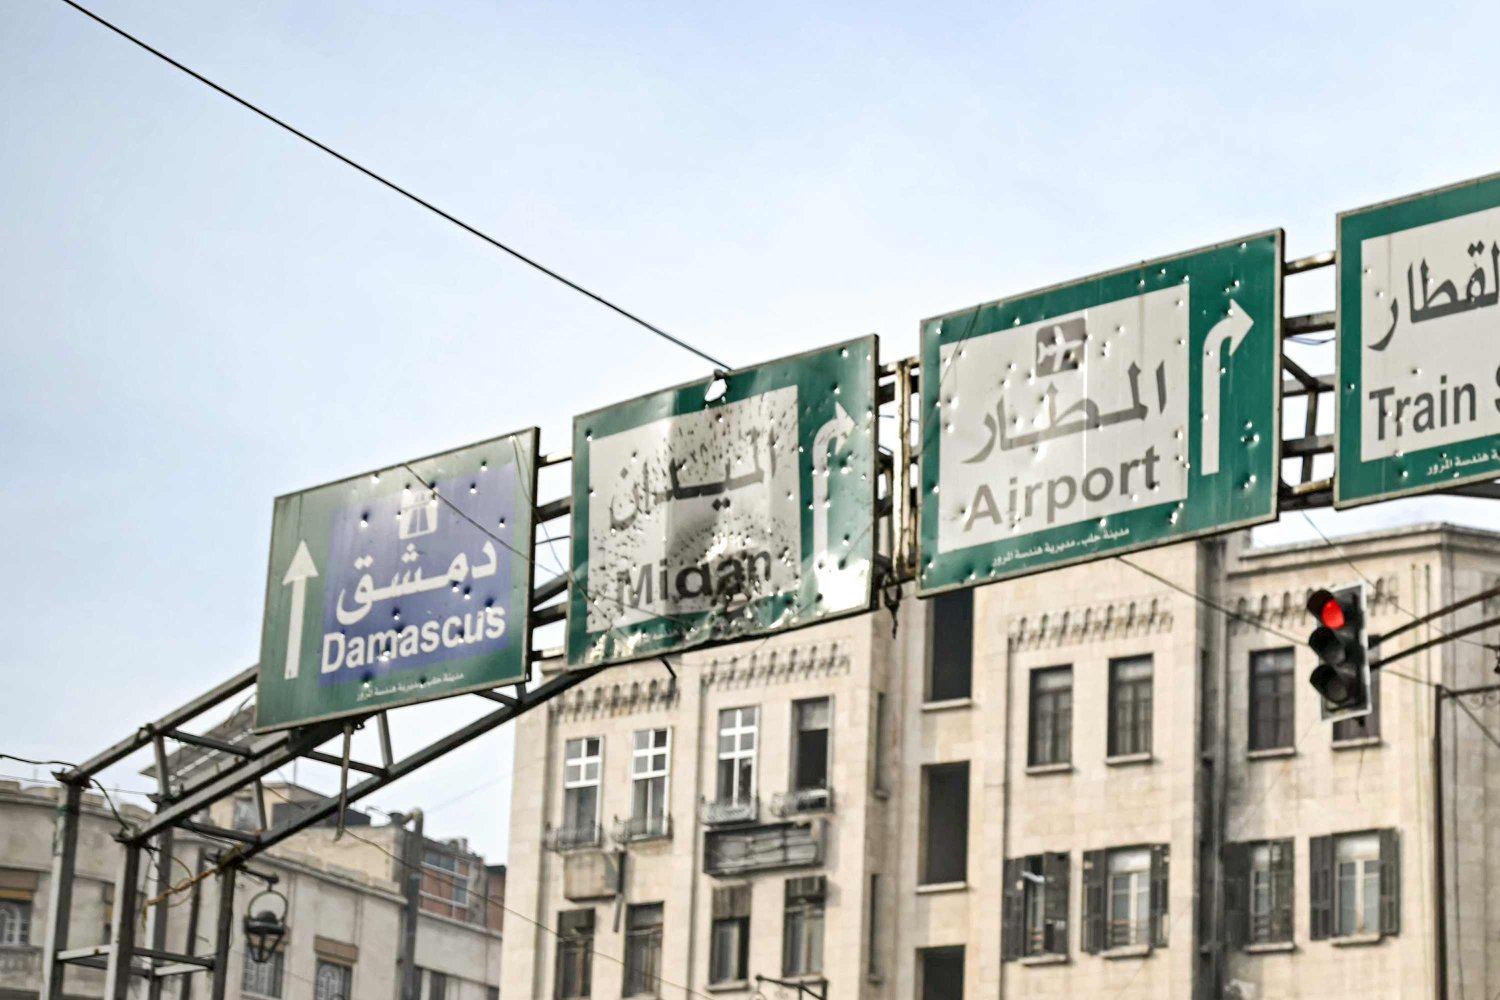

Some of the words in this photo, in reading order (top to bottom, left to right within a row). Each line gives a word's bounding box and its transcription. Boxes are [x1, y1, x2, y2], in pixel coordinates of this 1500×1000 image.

[961, 360, 1168, 464] المطار
[1369, 373, 1477, 443] Train
[962, 445, 1160, 533] Airport
[336, 540, 498, 626] دمشق
[321, 605, 506, 674] Damascus
